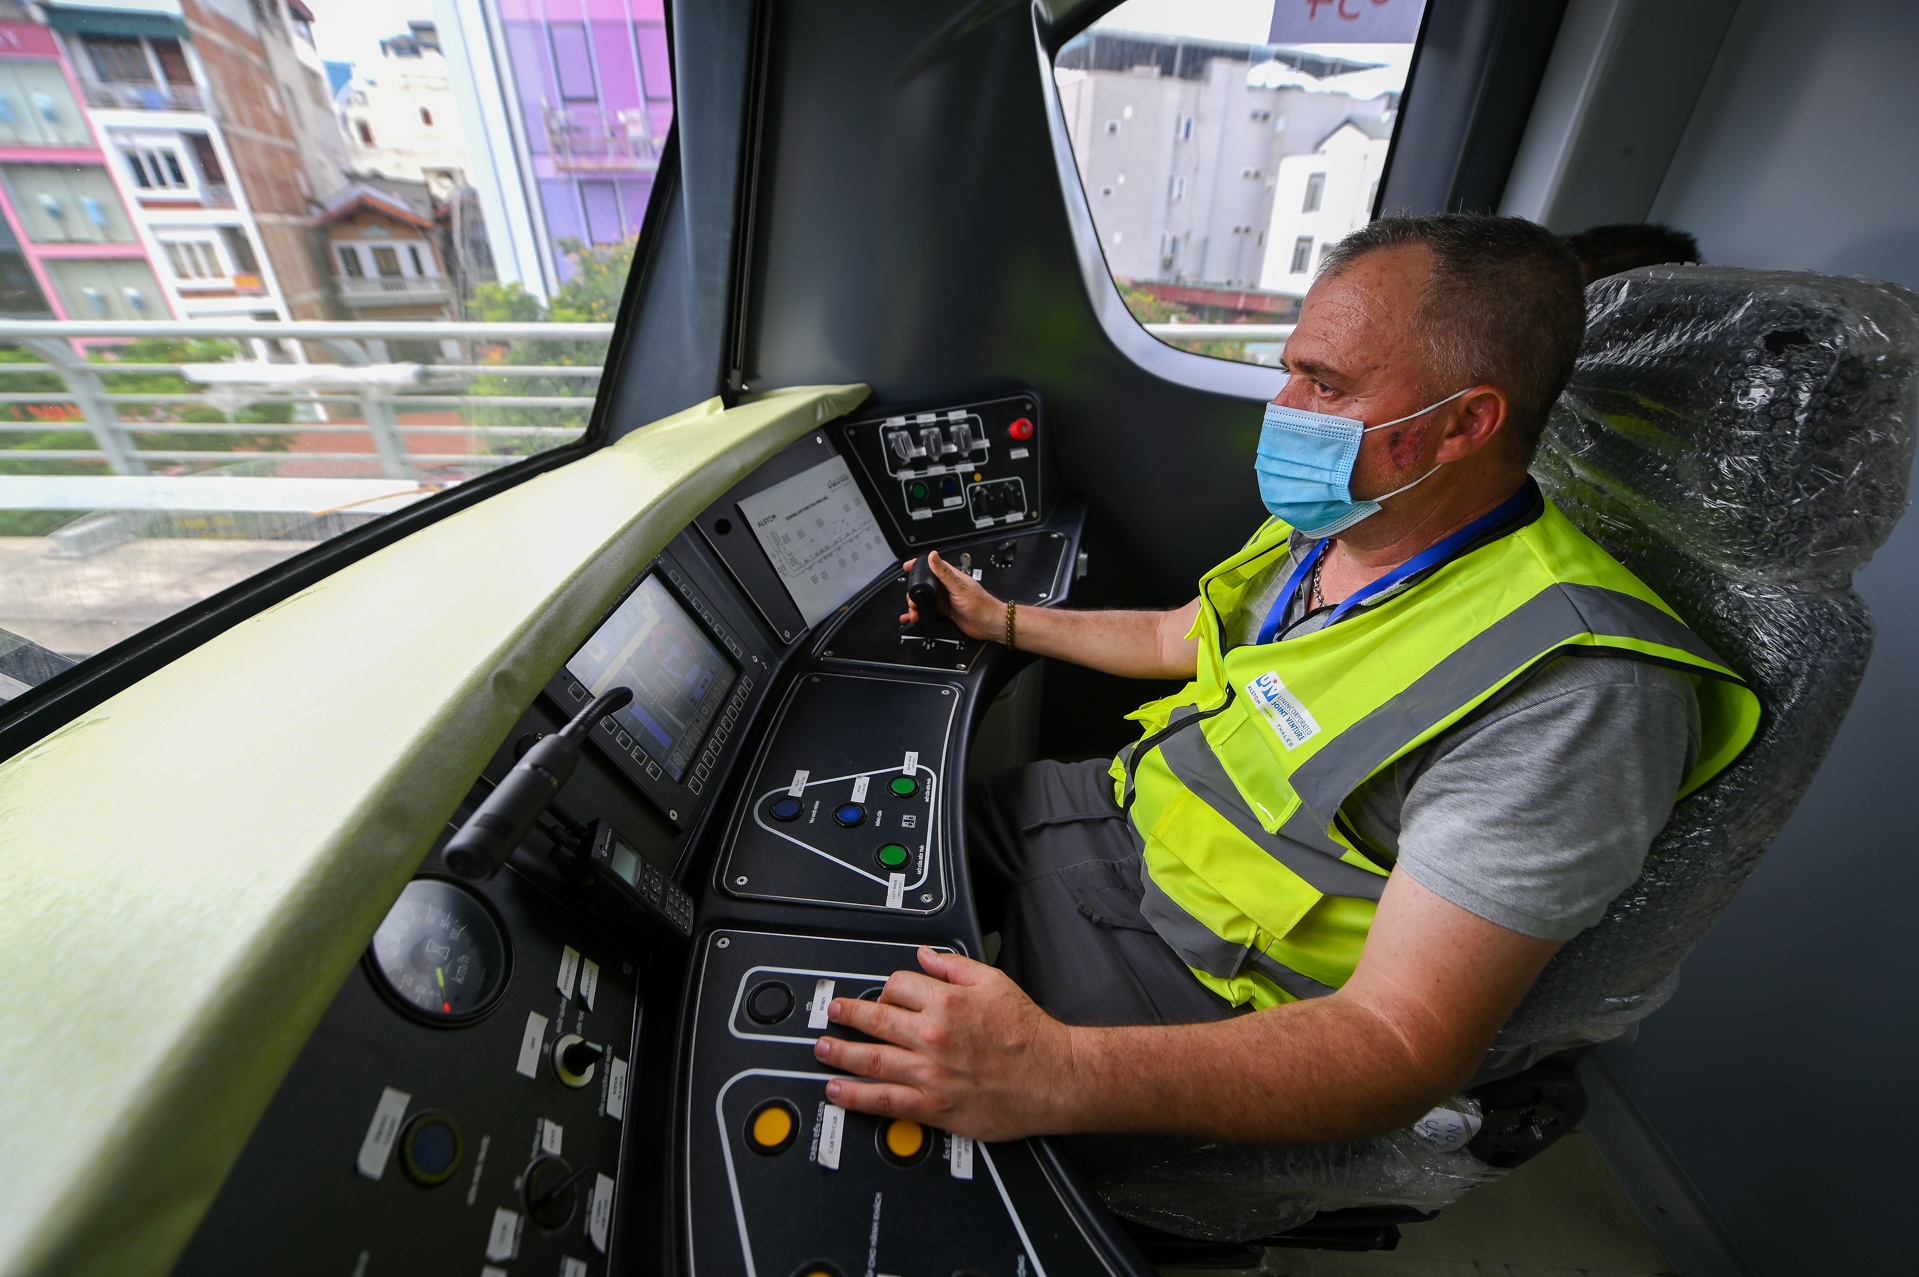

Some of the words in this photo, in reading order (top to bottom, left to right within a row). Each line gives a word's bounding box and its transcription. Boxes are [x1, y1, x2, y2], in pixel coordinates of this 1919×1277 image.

[757, 513, 777, 528] ALSTOM
[1247, 685, 1261, 705] ALSTOM
[1271, 701, 1288, 718] JOINT
[1285, 716, 1306, 741] VENTURE
[1278, 694, 1313, 736] UNINCORPORATED
[1276, 723, 1294, 747] THALES
[451, 954, 471, 984] km/h
[1445, 1123, 1461, 1142] NO
